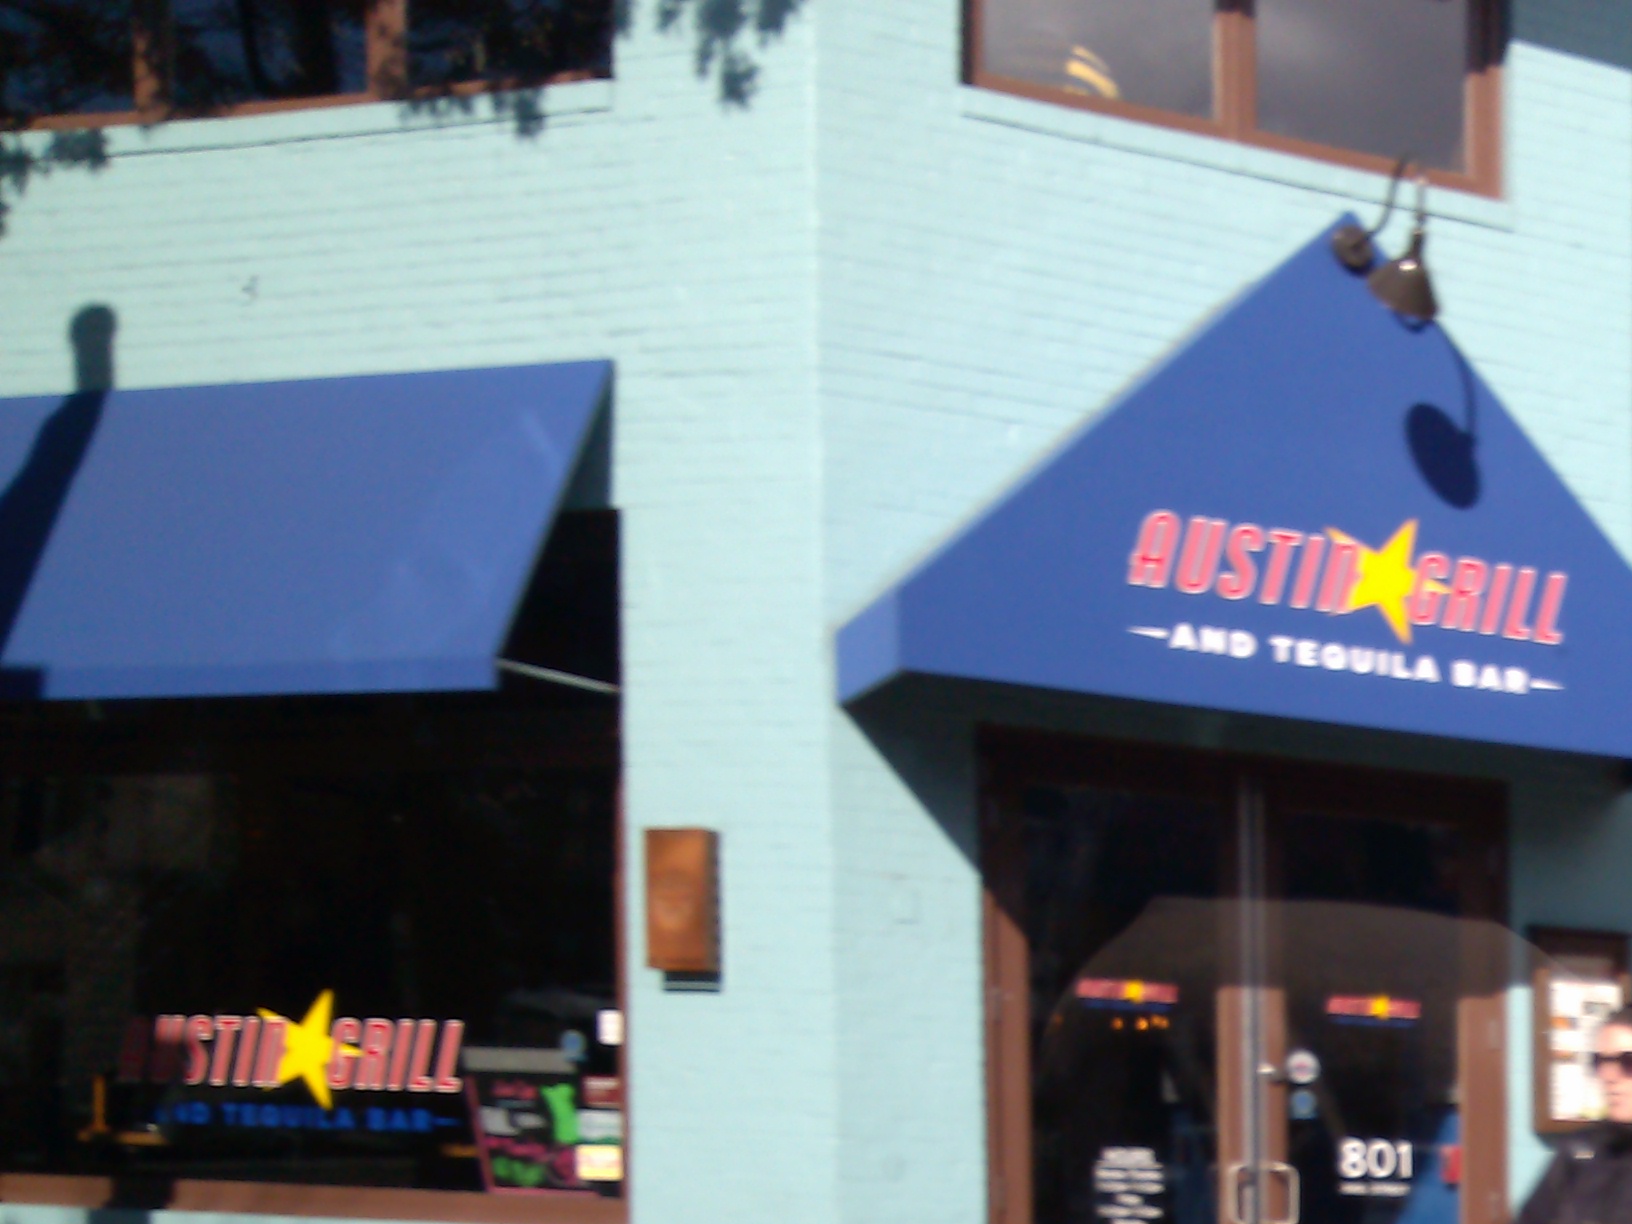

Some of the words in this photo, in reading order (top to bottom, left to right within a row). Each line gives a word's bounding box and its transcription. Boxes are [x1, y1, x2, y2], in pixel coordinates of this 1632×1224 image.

[1126, 509, 1359, 615] AUSTIN
[1409, 551, 1567, 645] GRILL
[1167, 621, 1257, 659] AND
[1269, 634, 1441, 683] TEQUILA
[1450, 658, 1531, 695] BAR
[327, 1017, 464, 1093] GRILL
[1339, 1137, 1413, 1178] 801
